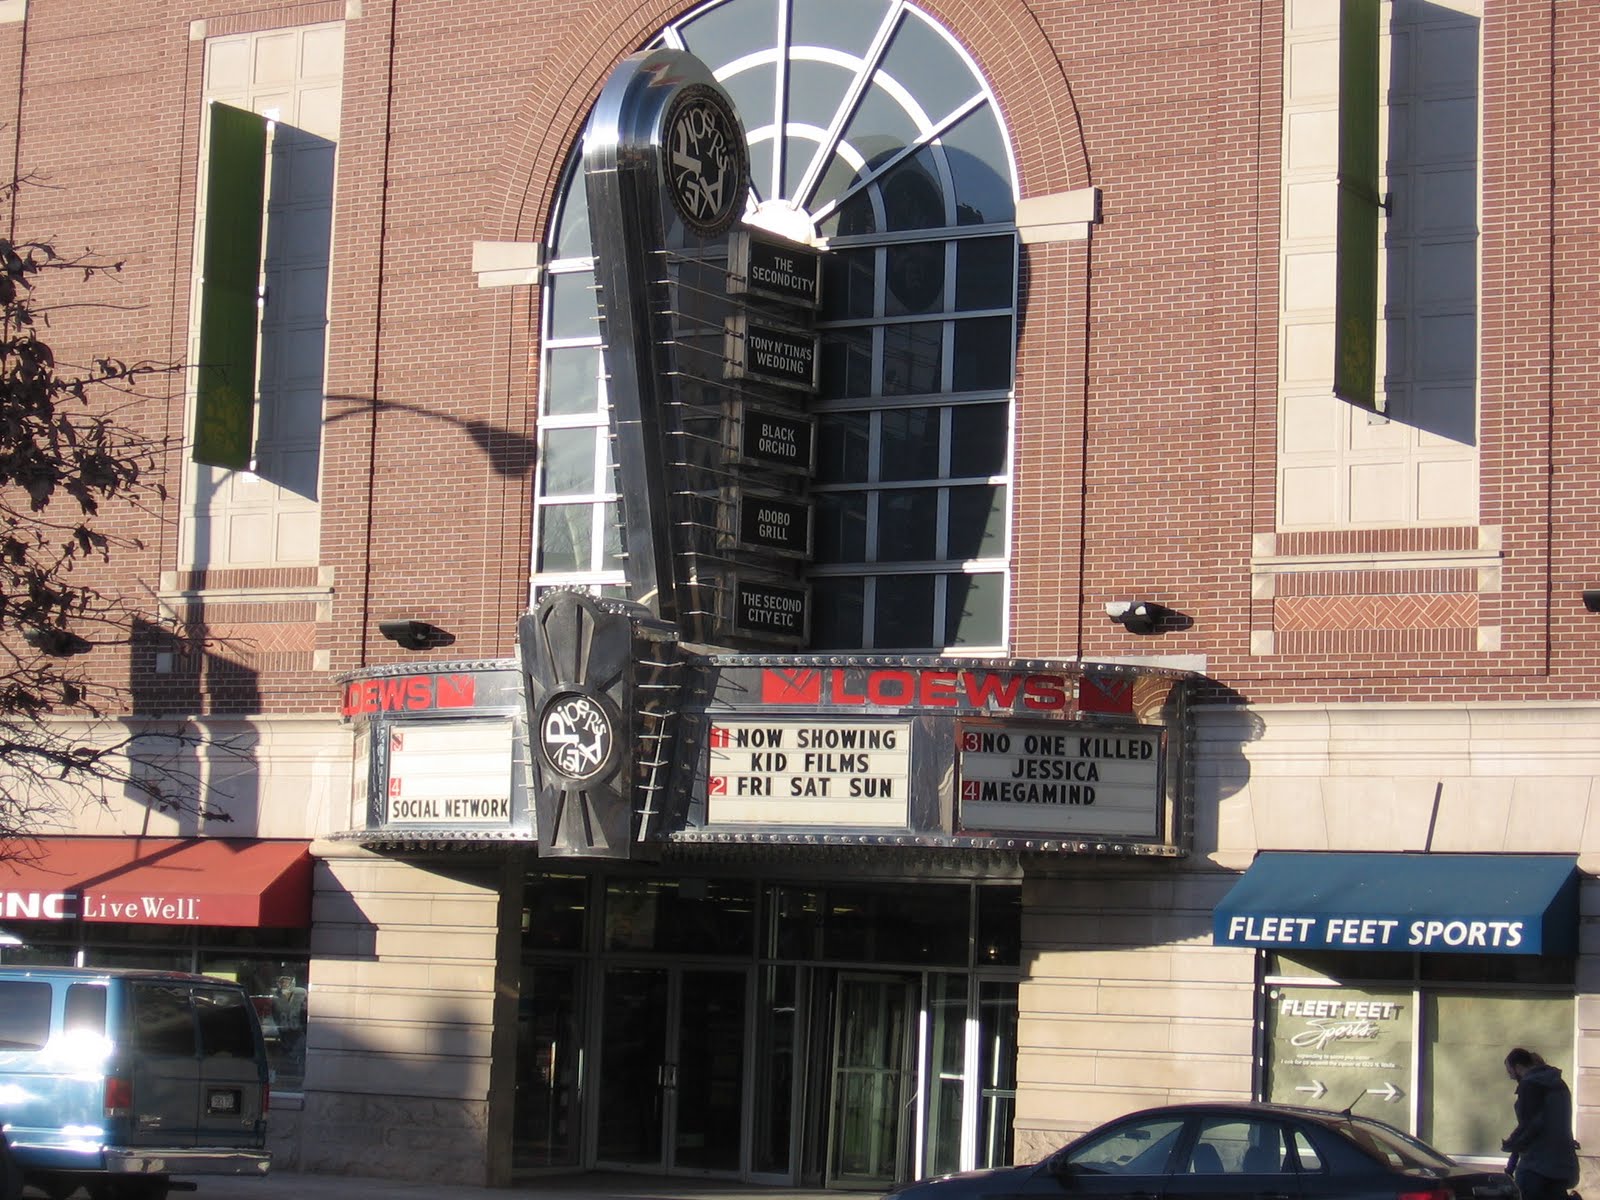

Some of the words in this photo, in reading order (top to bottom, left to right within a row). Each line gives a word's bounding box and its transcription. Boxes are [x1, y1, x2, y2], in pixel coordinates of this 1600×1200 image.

[774, 256, 794, 273] THE
[749, 335, 773, 351] TONY
[783, 343, 812, 361] TINA'S
[756, 351, 804, 374] WEDDING
[761, 423, 795, 442] BLACK
[758, 438, 797, 457] ORCHID
[757, 508, 791, 526] ADOBO
[759, 523, 788, 541] GRILL
[741, 591, 761, 608] THE
[763, 595, 802, 613] SECOND
[748, 608, 773, 625] CITY
[773, 610, 794, 627] ETC
[831, 668, 1066, 709] LOEWS
[737, 728, 783, 748] NOW
[797, 728, 896, 748] SHOWING
[965, 733, 978, 751] 3
[982, 732, 1011, 752] NO
[1024, 735, 1066, 756] ONE
[1079, 737, 1153, 760] KILLED
[751, 753, 787, 772] KID
[804, 753, 869, 773] FILMS
[1011, 759, 1100, 782] JESSICA
[711, 777, 725, 795] 2
[737, 777, 772, 796] FRI
[790, 777, 831, 797] SAT
[849, 778, 892, 798] SUN
[964, 783, 977, 800] 4
[981, 782, 1096, 806] MEGAMIND
[392, 799, 439, 818] SOCIAL
[445, 799, 508, 818] NETWORK
[0, 892, 77, 919] NC
[83, 895, 138, 918] Live
[1228, 917, 1316, 942] FLEET
[1325, 919, 1399, 944] FEET
[1408, 921, 1523, 947] SPORTS
[1280, 999, 1342, 1017] FLEET
[1343, 1001, 1395, 1018] FEET
[1290, 1018, 1370, 1050] Sports
